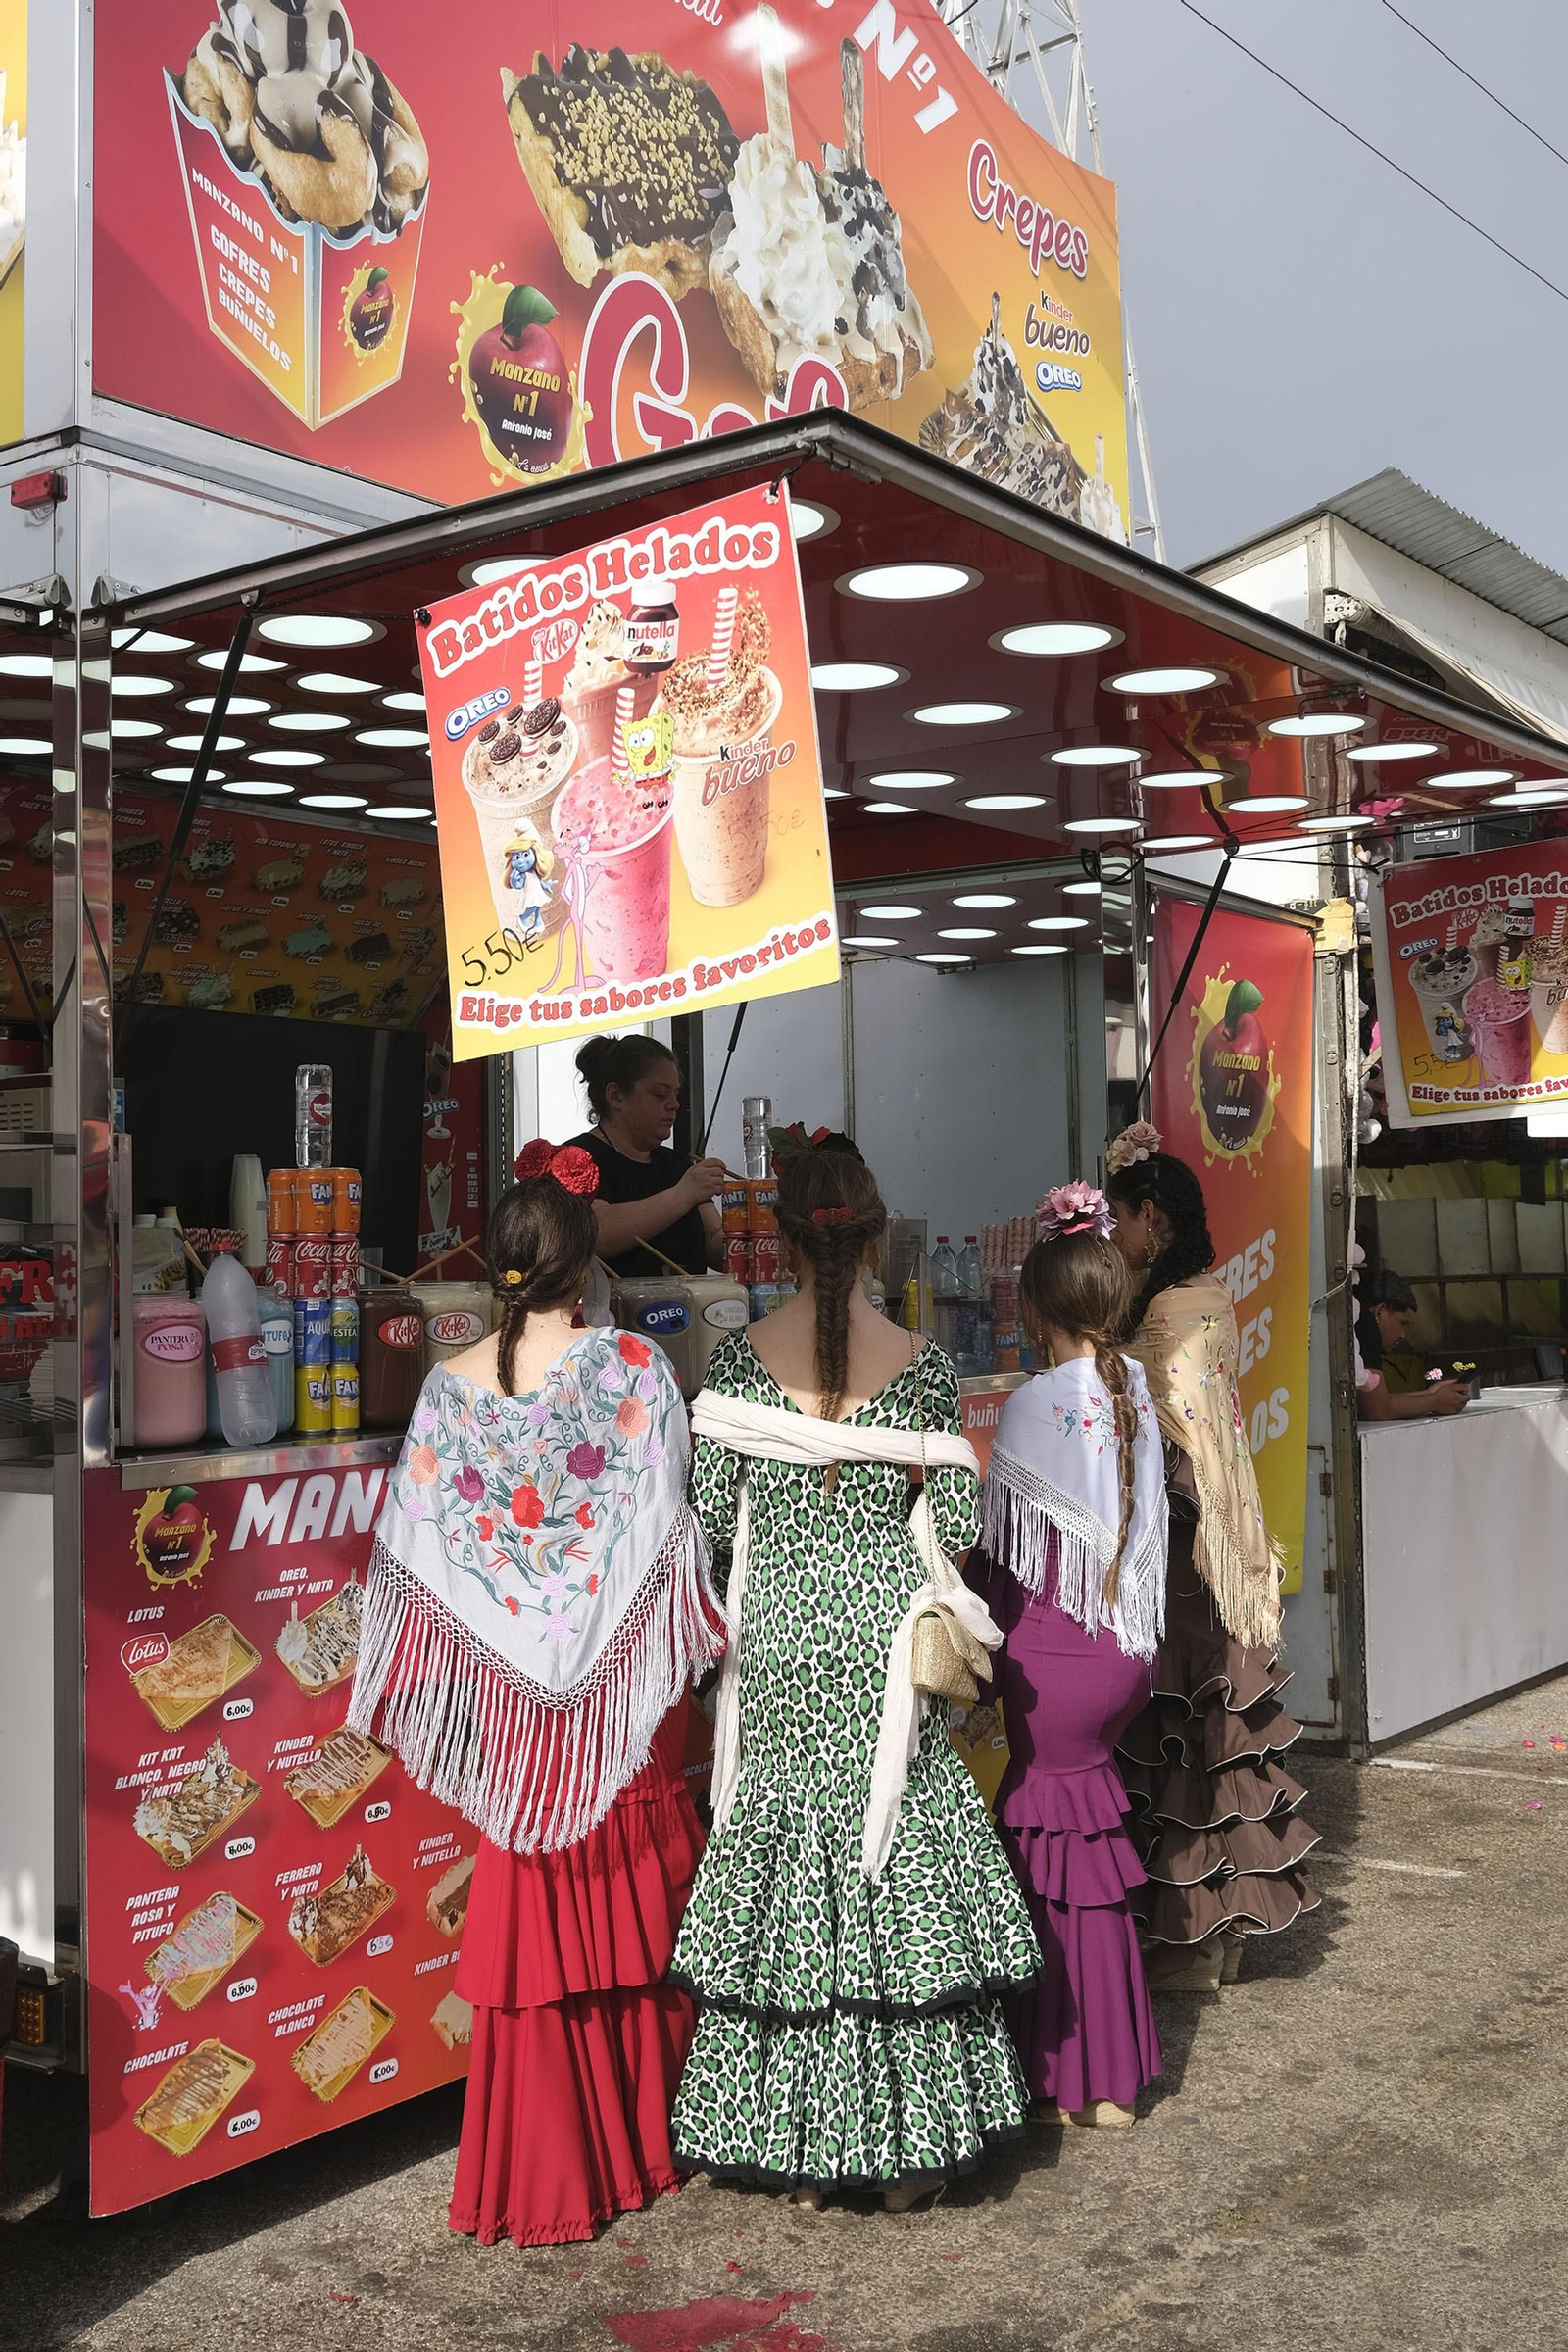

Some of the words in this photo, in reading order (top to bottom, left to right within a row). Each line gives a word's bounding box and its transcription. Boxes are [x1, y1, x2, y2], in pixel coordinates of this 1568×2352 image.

[192, 168, 264, 243] MANZANO
[967, 138, 1088, 278] Crepes
[211, 224, 271, 294] GOFRES
[219, 262, 276, 330] CREPES
[360, 299, 389, 314] Manzano
[219, 286, 292, 372] BUÑUELOS
[1025, 303, 1090, 357] bueno
[490, 357, 561, 392] Manzano
[1036, 362, 1081, 390] OREO
[502, 418, 532, 436] Antonio
[429, 568, 584, 672] Batidos
[591, 524, 775, 591] Helados
[627, 621, 675, 640] nutella
[446, 687, 511, 739] OREO
[702, 741, 796, 807] bueno
[1392, 888, 1483, 925] Batidos
[1399, 938, 1439, 959] OREO
[460, 996, 522, 1027] Elige
[529, 999, 573, 1021] tus
[580, 976, 686, 1018] sabores
[692, 917, 832, 991] favoritos
[1212, 1050, 1261, 1072] Manzano
[1411, 1086, 1451, 1102] Elige
[1453, 1090, 1480, 1102] tus
[1483, 1084, 1543, 1101] sabores
[441, 1317, 467, 1337] KitKat
[645, 1308, 683, 1325] OREO
[151, 1334, 189, 1344] PANTERA
[331, 1328, 358, 1337] ESTEA
[157, 1343, 184, 1351] rosa
[1244, 1387, 1290, 1455] OS
[228, 1467, 391, 1551] MAN
[155, 1523, 197, 1538] Manzano
[255, 1584, 294, 1602] KINDER
[296, 1585, 304, 1596] Y
[307, 1579, 333, 1593] NATA
[127, 1605, 165, 1623] LOTUS
[129, 1640, 165, 1664] Lotus
[138, 1750, 159, 1767] KIT
[161, 1746, 185, 1762] KAT
[274, 1735, 314, 1754] KINDER
[168, 1759, 207, 1779] NEGRO
[267, 1759, 275, 1773] Y
[276, 1748, 322, 1770] NUTELLA
[140, 1788, 151, 1801] Y
[152, 1781, 184, 1799] NATA
[418, 1832, 454, 1852] KINDER
[412, 1857, 420, 1870] Y
[420, 1845, 462, 1867] NUTELLA
[274, 1862, 323, 1886] FERRERO
[125, 1885, 180, 1911] PANTERA
[280, 1887, 290, 1901] Y
[290, 1880, 319, 1899] NATA
[131, 1906, 164, 1927] ROSA
[167, 1903, 176, 1917] Y
[132, 1922, 174, 1944] PITUFO
[414, 1954, 449, 1976] KINDER
[268, 1994, 326, 2025] CHOCOLATE
[274, 2014, 316, 2038] BLANCO
[123, 2041, 190, 2074] CHOCOLATE
